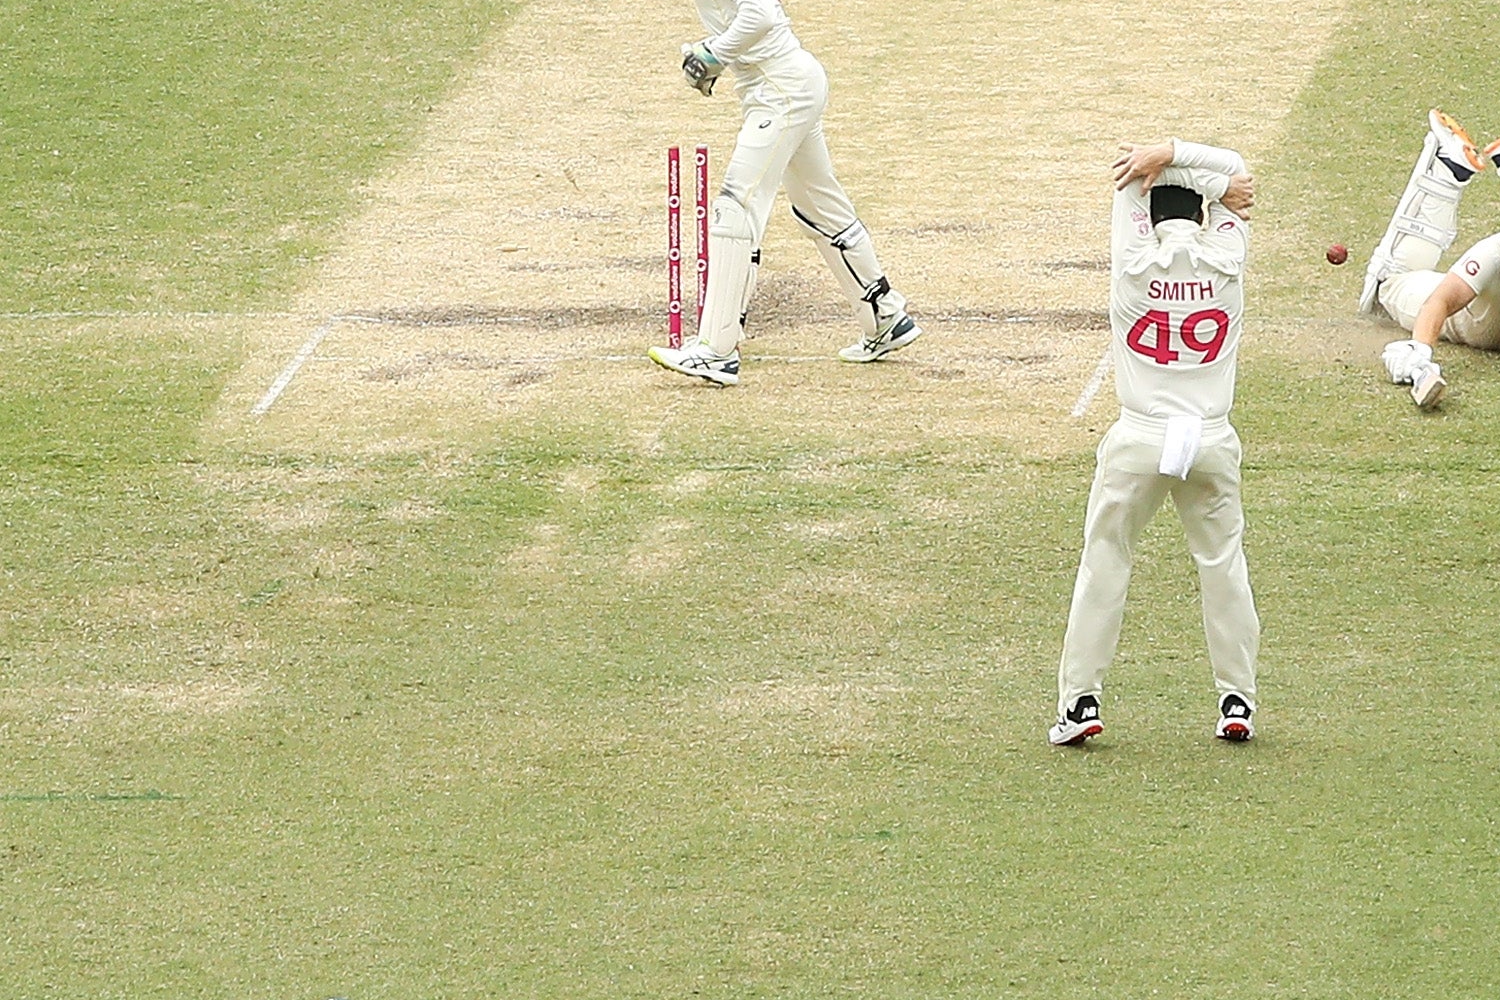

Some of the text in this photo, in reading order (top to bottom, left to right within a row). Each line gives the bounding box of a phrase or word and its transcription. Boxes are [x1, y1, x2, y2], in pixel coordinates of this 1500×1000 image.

[670, 159, 678, 194] vodafone
[670, 213, 678, 247] vodafone
[671, 265, 679, 299] vodafone
[1148, 280, 1214, 301] SMITH
[1126, 308, 1230, 365] 49
